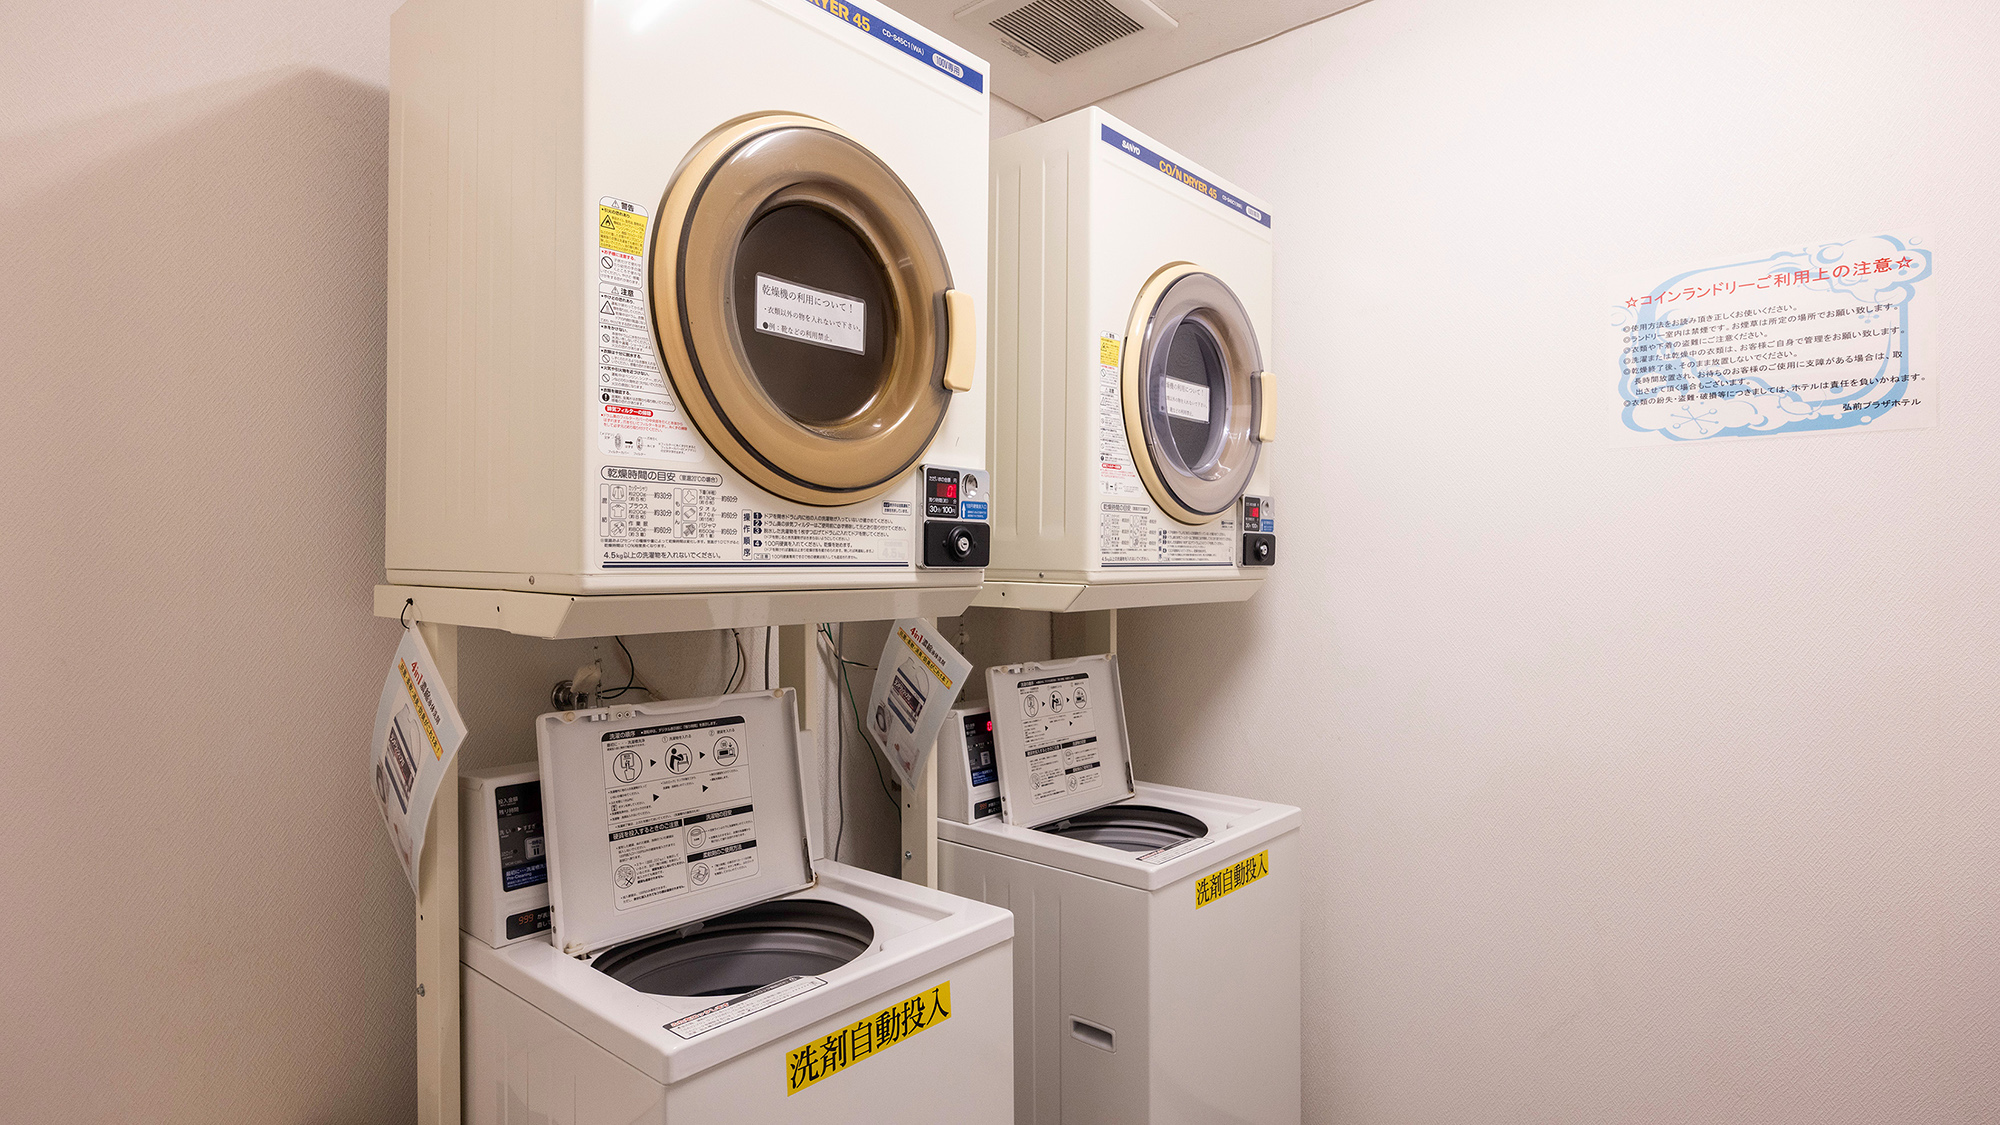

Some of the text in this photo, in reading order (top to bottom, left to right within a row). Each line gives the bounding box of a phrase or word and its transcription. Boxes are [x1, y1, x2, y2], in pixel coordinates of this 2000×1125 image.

[853, 13, 871, 32] 45
[1122, 140, 1140, 155] SANYO
[1184, 173, 1207, 194] DRYER
[1209, 188, 1217, 200] 45
[762, 284, 853, 314] 乾燥機の利用について！
[1842, 398, 1922, 412] 弘前プラザホテル
[608, 468, 675, 482] 乾燥時間の目安
[604, 551, 721, 559] 4.5kg以上の洗濯物を入れないでください。
[1197, 854, 1268, 906] 洗剤自動投入
[790, 987, 949, 1089] 洗剤自動投入
